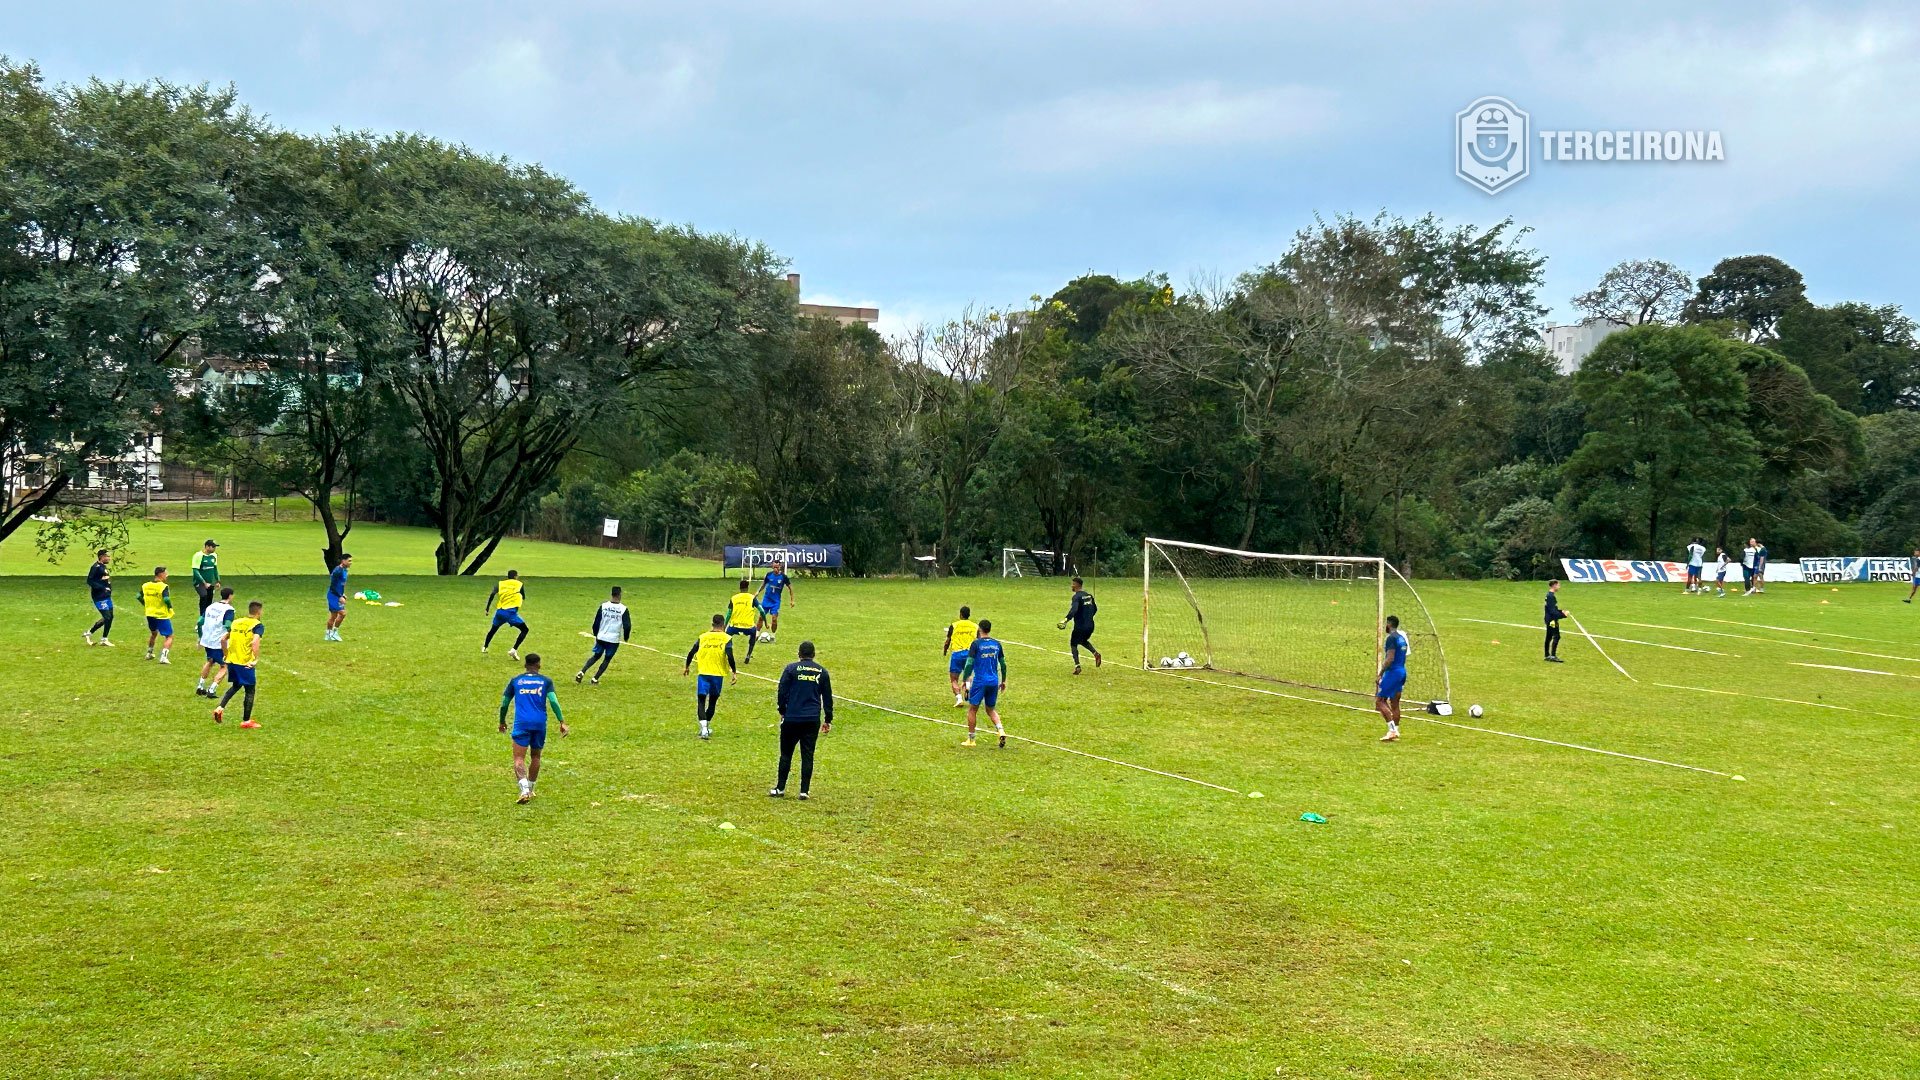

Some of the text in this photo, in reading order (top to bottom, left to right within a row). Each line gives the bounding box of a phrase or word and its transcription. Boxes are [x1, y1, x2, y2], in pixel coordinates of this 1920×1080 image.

[763, 549, 827, 563] banrisul
[1804, 561, 1842, 572] TEK
[1871, 561, 1908, 572] TEK
[1804, 572, 1842, 583] BOND
